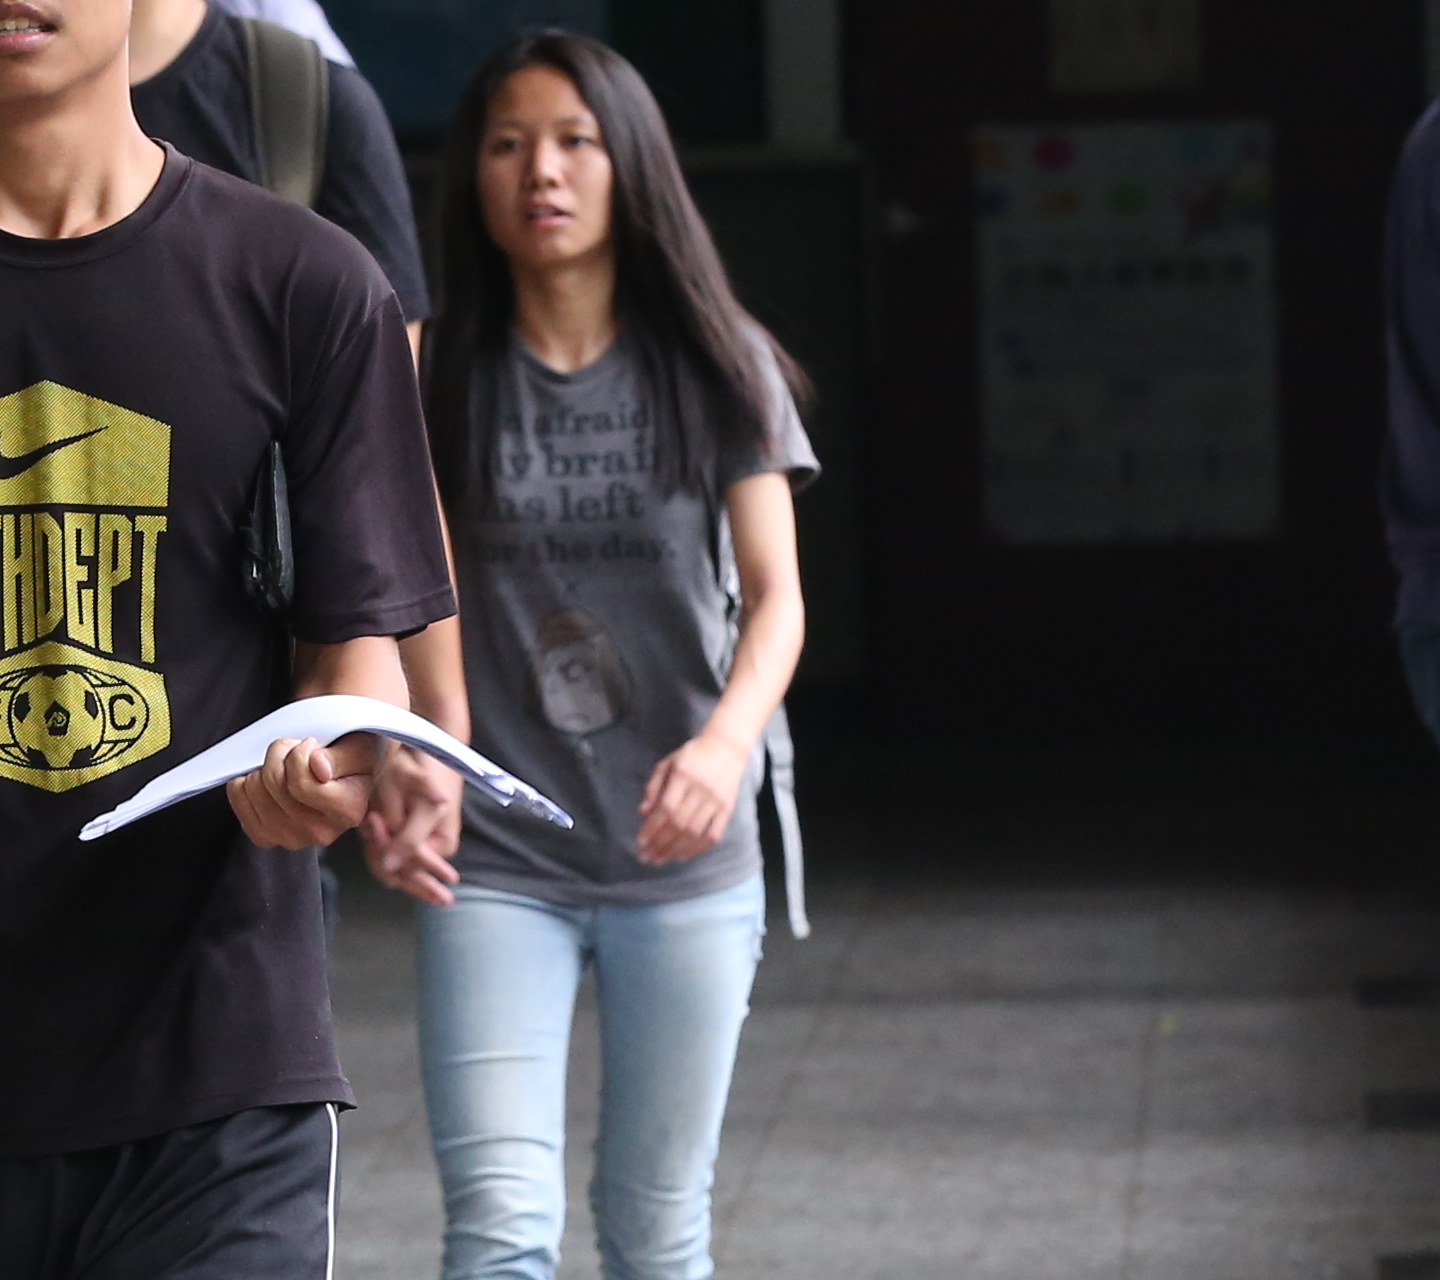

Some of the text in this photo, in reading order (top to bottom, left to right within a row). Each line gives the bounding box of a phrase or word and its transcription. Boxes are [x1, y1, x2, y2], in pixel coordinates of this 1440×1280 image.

[541, 439, 651, 477] brai
[558, 483, 646, 521] left
[106, 692, 136, 730] C
